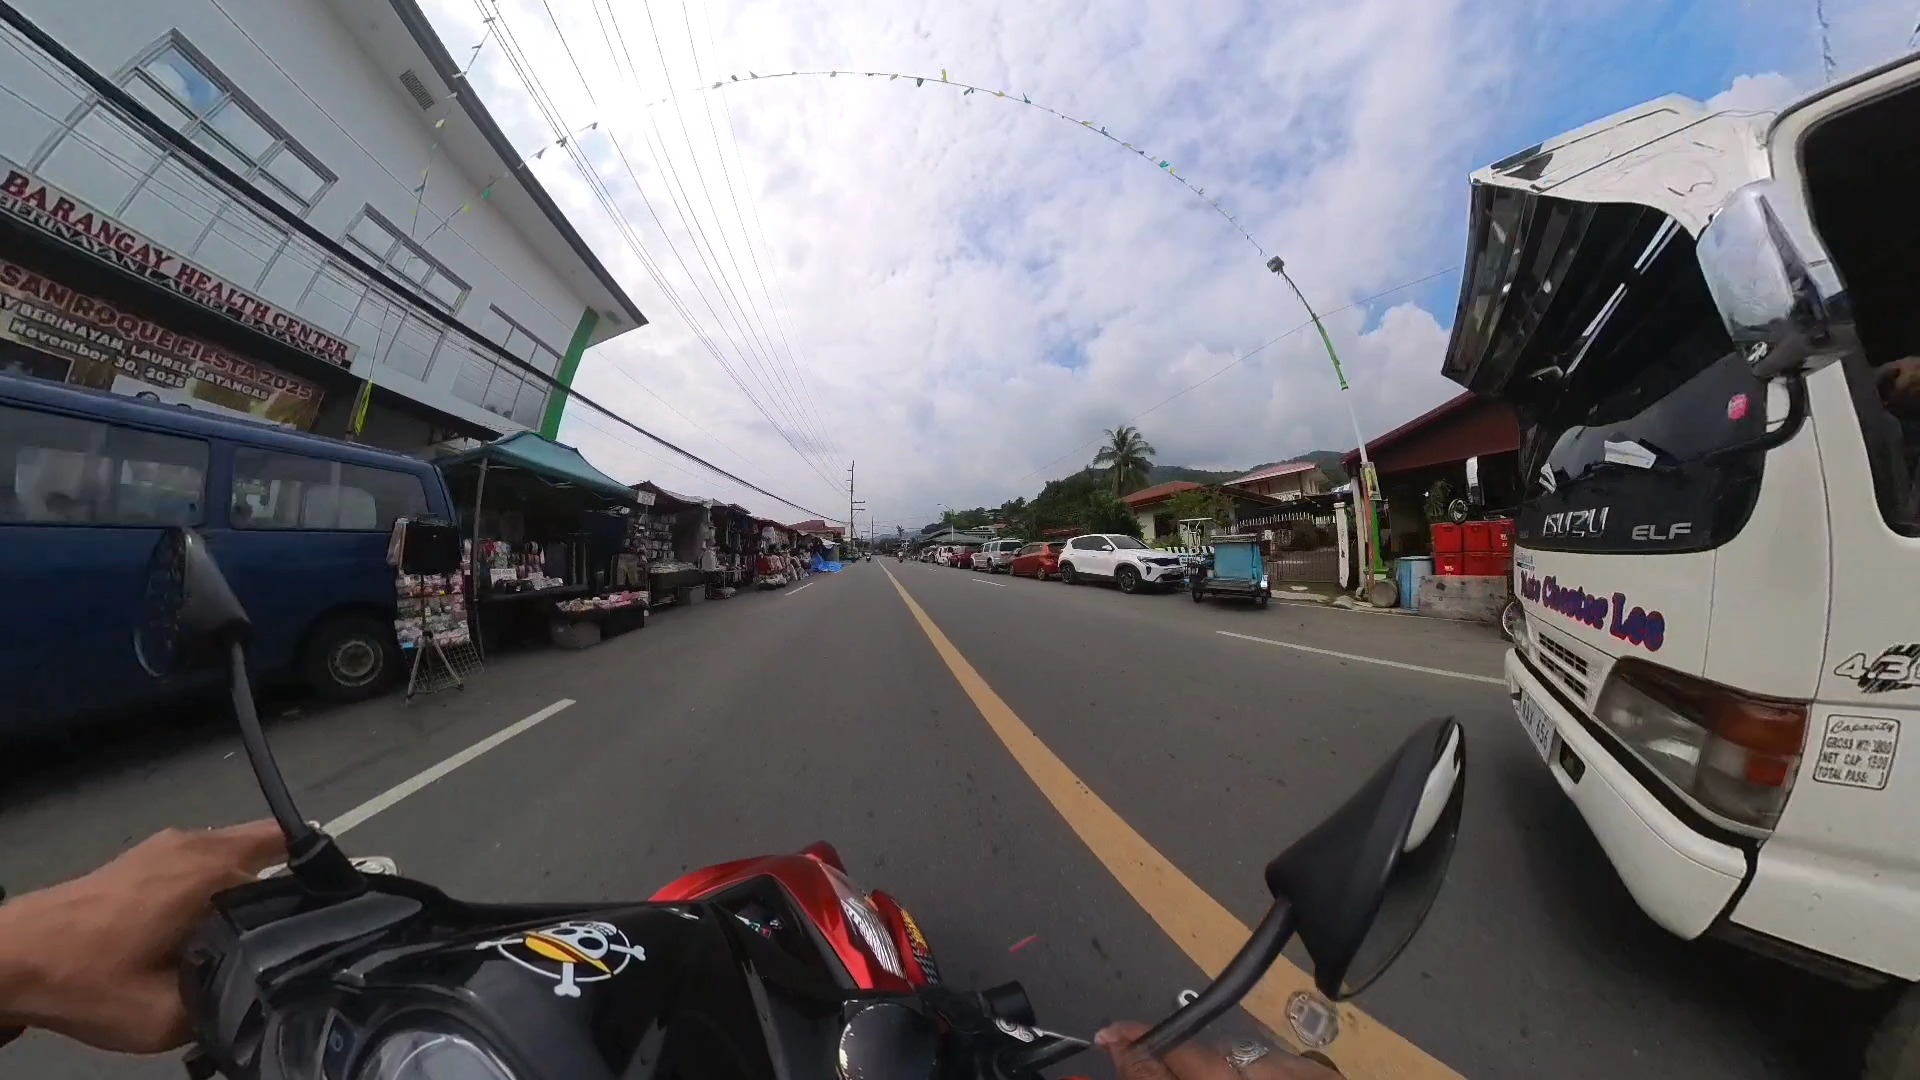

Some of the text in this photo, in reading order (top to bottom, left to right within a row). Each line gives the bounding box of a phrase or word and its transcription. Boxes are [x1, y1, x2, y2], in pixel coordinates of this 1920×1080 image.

[0, 170, 349, 359] BARANGAY HEALTH CENTER
[0, 263, 313, 400] SAN ROQUE FIESTA 2025
[10, 319, 109, 363] November
[114, 355, 139, 375] 30,
[195, 367, 270, 401] BATANGAS
[1543, 506, 1609, 538] ISUZU
[1632, 522, 1691, 541] ELF
[1610, 592, 1665, 652] Lee
[1830, 719, 1895, 734] Capacity
[1822, 752, 1838, 765] NET
[1826, 736, 1854, 750] GROSS
[1818, 766, 1842, 780] TOTAL
